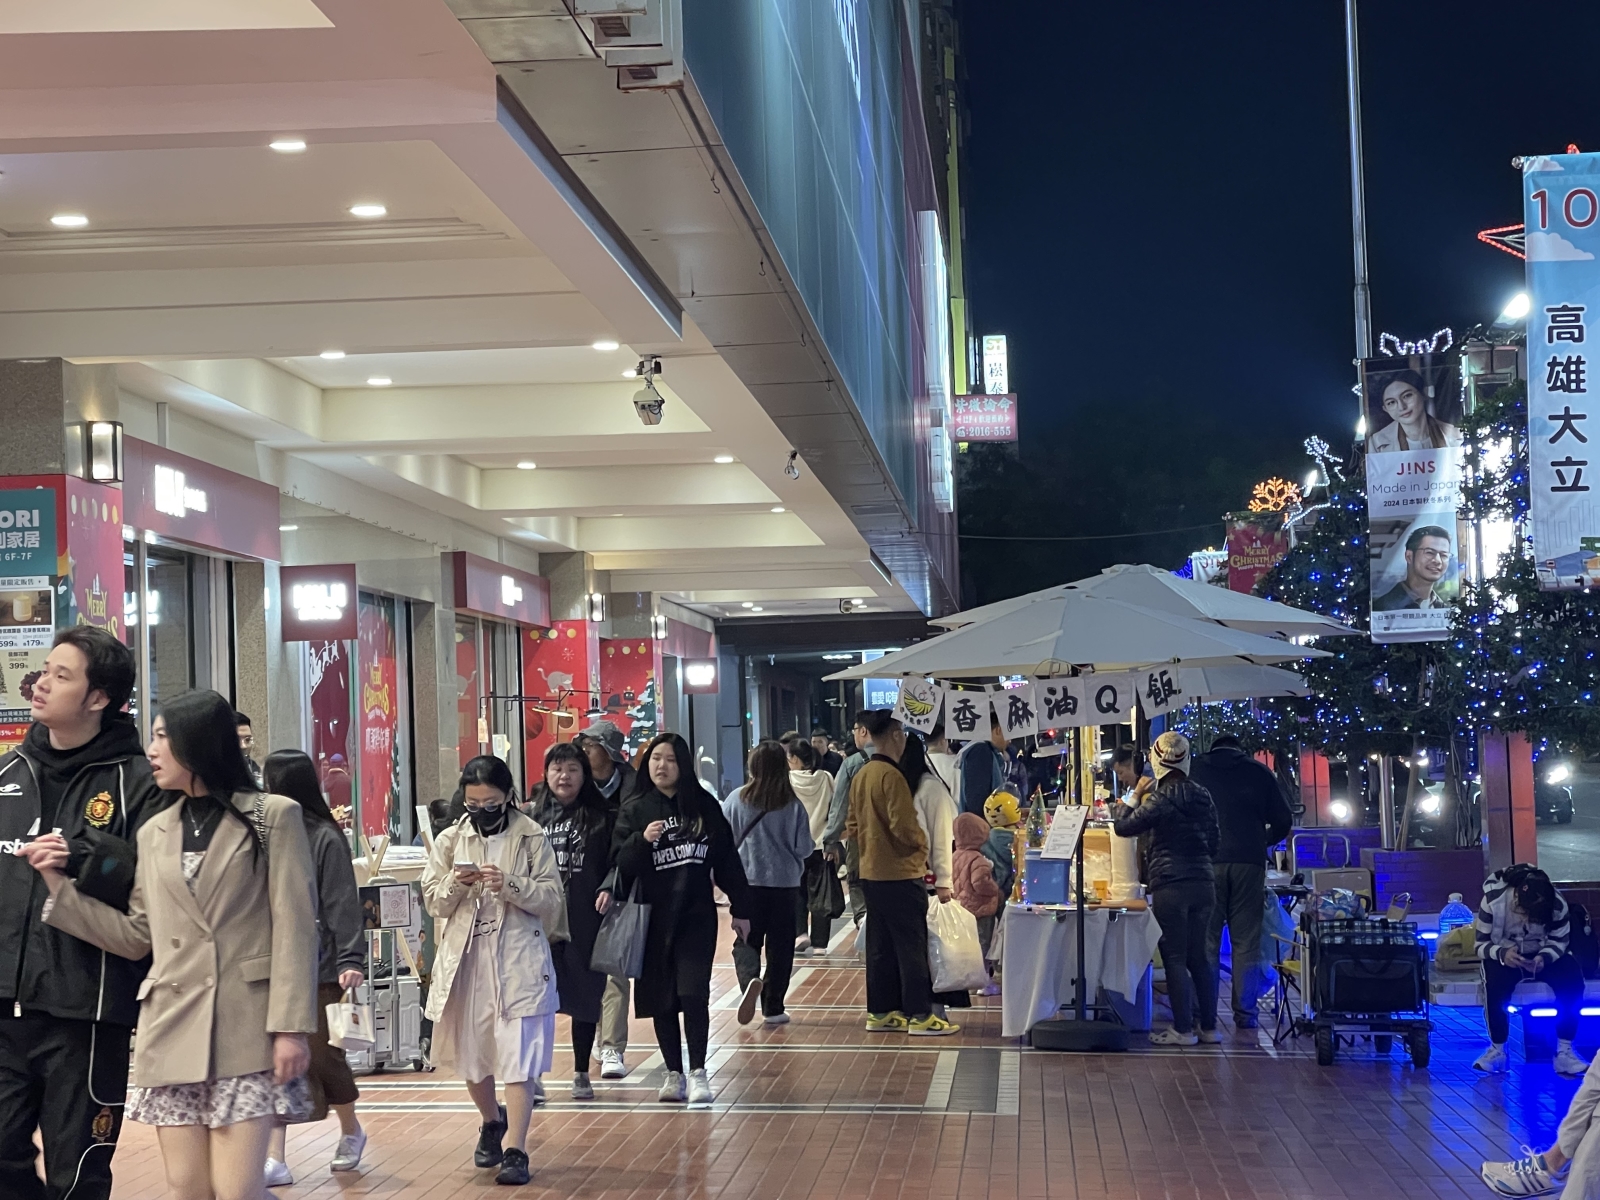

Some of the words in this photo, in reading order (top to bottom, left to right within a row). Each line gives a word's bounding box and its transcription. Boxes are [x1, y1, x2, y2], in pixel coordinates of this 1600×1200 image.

[1545, 303, 1591, 494] 高雄大立
[1372, 483, 1407, 494] Made
[1410, 481, 1420, 491] in
[1402, 496, 1452, 506] 日本製秋冬系列
[5, 552, 32, 561] 6F-7F
[1243, 545, 1271, 556] MERRY
[1230, 552, 1284, 567] CHRISTMAS
[85, 588, 107, 621] MERRY
[652, 847, 676, 866] PAPER
[675, 842, 709, 859] COMPANY
